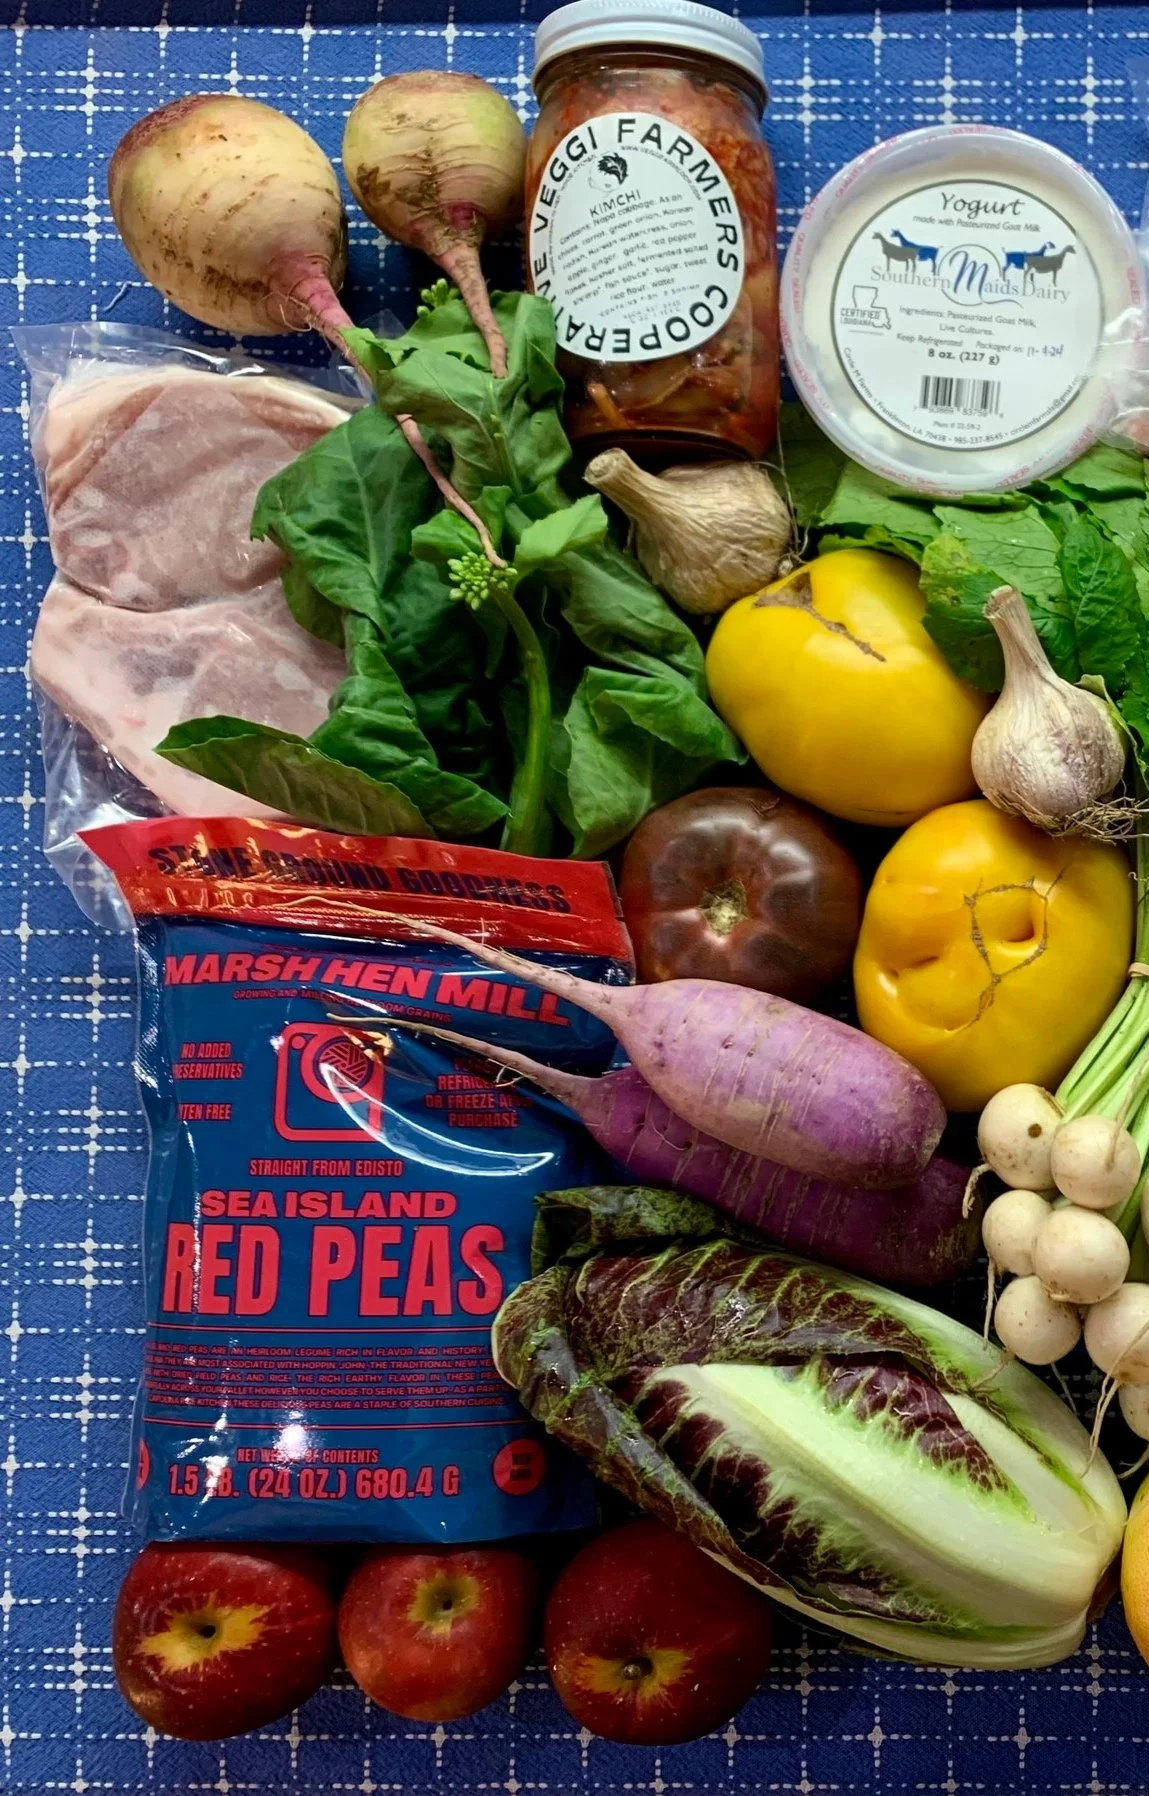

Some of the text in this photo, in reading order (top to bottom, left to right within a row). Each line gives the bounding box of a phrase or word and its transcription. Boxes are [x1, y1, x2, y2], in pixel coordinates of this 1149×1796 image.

[534, 126, 598, 233] VEGGI
[618, 119, 738, 272] FARMERS
[589, 189, 641, 217] KIMCHI
[941, 192, 1026, 219] Yogurt
[912, 215, 1041, 232] made with Pasteurized Goat Milk
[870, 250, 1071, 303] Southern Maids Dairy
[840, 308, 880, 319] CERTIFIED
[928, 348, 1000, 366] 8 oz. (227 g)
[147, 846, 572, 915] STONE GROUND GOODNESS
[163, 952, 570, 1026] MARSH HEN MILL
[181, 1042, 232, 1058] NO ADDED
[447, 1094, 495, 1108] FREEZE
[206, 1104, 232, 1120] FREE
[448, 1113, 518, 1127] PURCHASE
[249, 1160, 404, 1176] STRAIGHT FROM EDISTO
[201, 1190, 457, 1218] SEA ISLAND
[162, 1223, 505, 1317] RED PEAS
[295, 1346, 483, 1356] LEGUME RICH FLAVOR HISTORY
[391, 1361, 452, 1369] TRADITIONAL
[323, 1449, 379, 1464] CONTENTS
[169, 1463, 460, 1499] 1.5 (24 OZ.) 680.4 G
